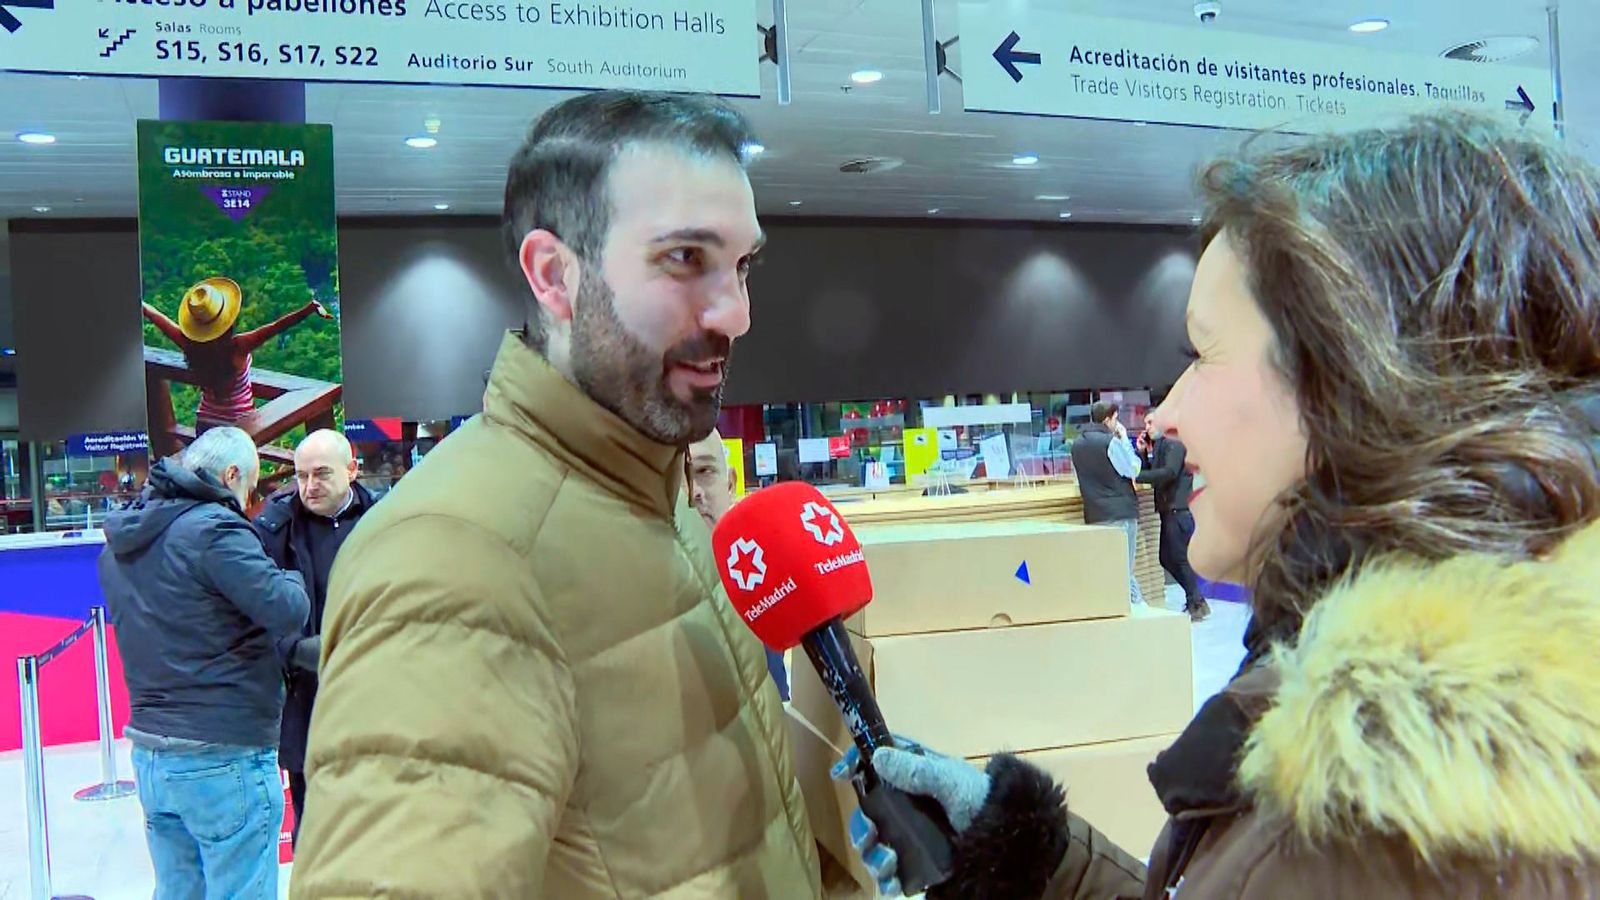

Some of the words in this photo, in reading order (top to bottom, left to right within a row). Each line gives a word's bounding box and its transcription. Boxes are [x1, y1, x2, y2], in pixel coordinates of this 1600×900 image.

[155, 21, 192, 33] Salas
[199, 23, 242, 36] Rooms
[424, 0, 507, 22] Access
[516, 5, 541, 24] to
[550, 4, 665, 31] Exhibition
[674, 10, 726, 36] Halls
[155, 40, 208, 64] S15,
[218, 42, 270, 66] S16,
[279, 44, 325, 67] S17,
[335, 46, 379, 67] S22
[408, 52, 497, 71] Auditorio
[504, 57, 534, 73] Sur
[547, 57, 594, 76] South
[599, 61, 687, 80] Auditorium
[1069, 45, 1190, 75] Acreditación
[1197, 57, 1218, 77] de
[1225, 61, 1306, 85] visitantes
[1312, 71, 1421, 98] profesionales.
[1424, 81, 1486, 104] Taquillas
[1070, 73, 1119, 97] Trade
[1124, 78, 1188, 102] Visitors
[1296, 94, 1347, 117] Tickets
[164, 147, 305, 166] GUATEMALA
[173, 168, 232, 179] Asombrosa
[223, 199, 250, 208] 3E14
[227, 190, 251, 198] STAND
[814, 549, 864, 575] TeleMadrid
[744, 576, 797, 622] TeleMadrid
